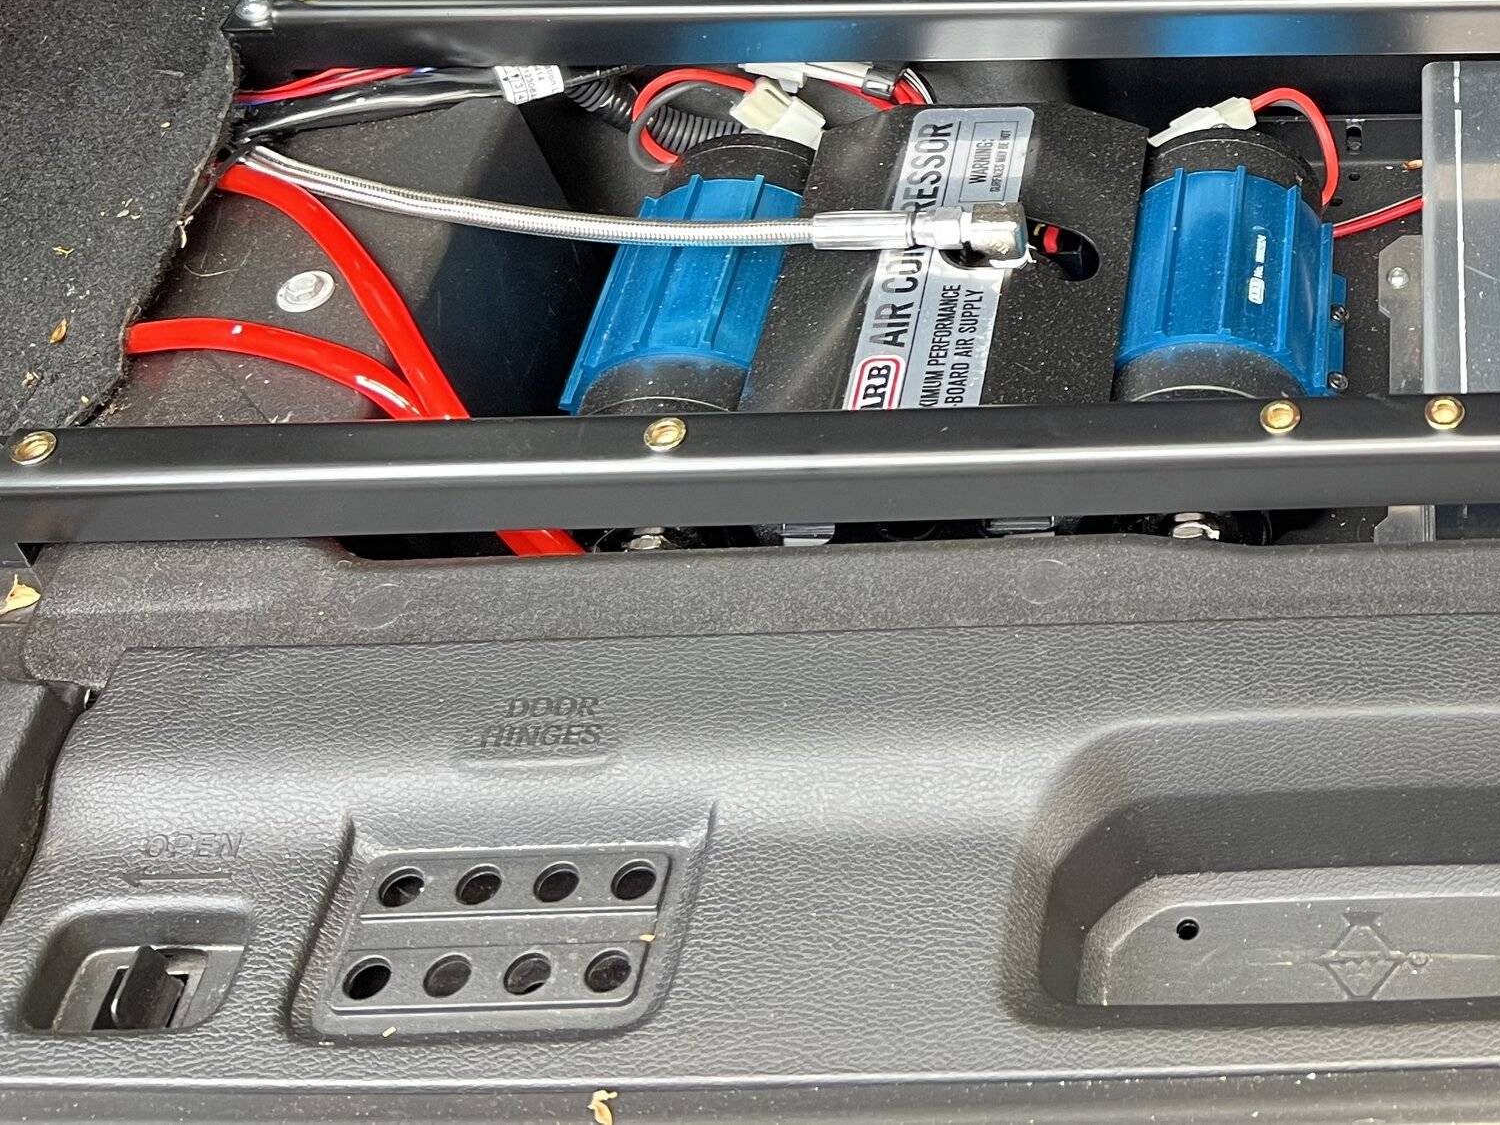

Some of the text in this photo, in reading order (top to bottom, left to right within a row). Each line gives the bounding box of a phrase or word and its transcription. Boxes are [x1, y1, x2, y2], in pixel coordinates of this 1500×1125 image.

[881, 123, 954, 293] CORESSOR
[869, 302, 914, 348] AIR
[927, 284, 961, 366] PERFORMANCE
[958, 289, 984, 334] SUPPLY
[954, 338, 975, 357] AIR
[504, 697, 600, 718] DOOR
[479, 724, 603, 747] HINGES
[146, 832, 243, 858] OPEN
